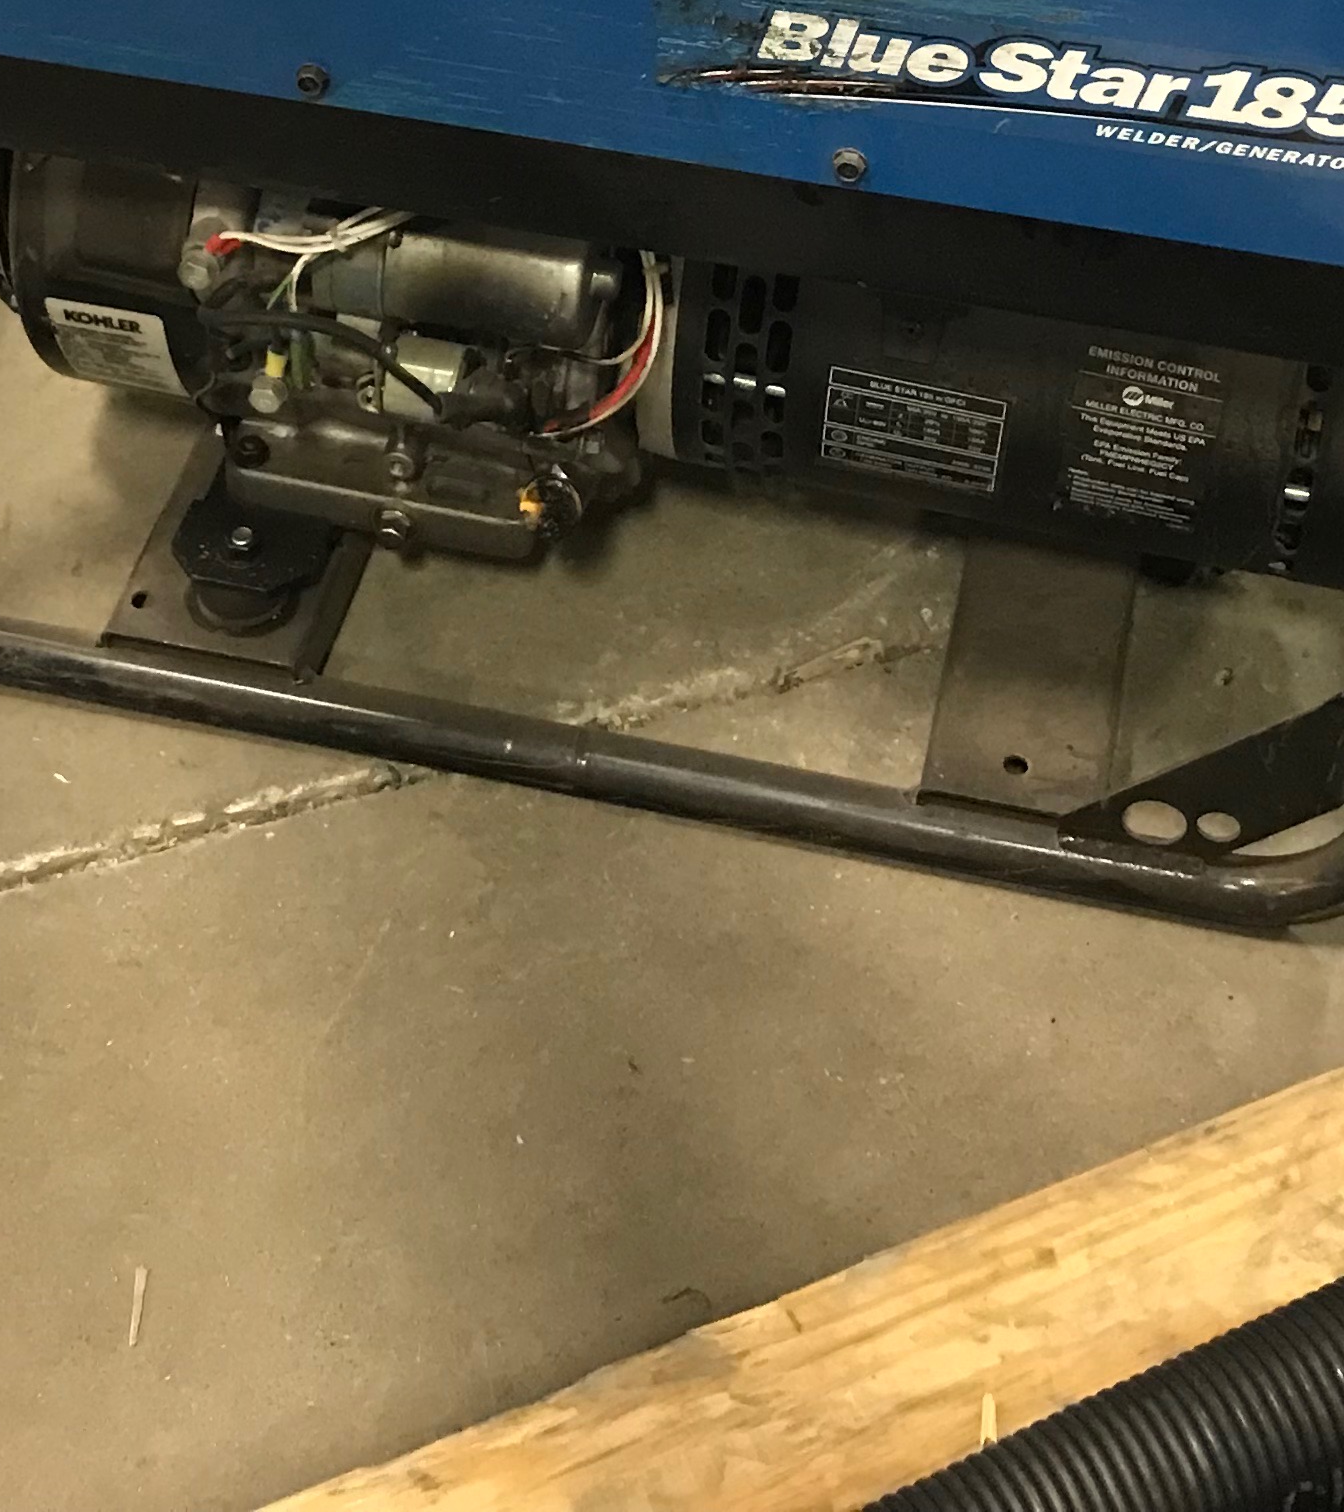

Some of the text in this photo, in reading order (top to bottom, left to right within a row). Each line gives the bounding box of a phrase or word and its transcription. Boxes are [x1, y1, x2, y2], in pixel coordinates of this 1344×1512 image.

[757, 9, 971, 84] Blue
[979, 41, 1189, 115] Star
[62, 307, 143, 335] KOHLER
[1088, 344, 1221, 383] EMISSION CONTROL
[869, 380, 892, 391] BLUE
[894, 385, 917, 396] STAR
[1105, 362, 1198, 393] INFORMATION
[1085, 398, 1118, 413] MILLER
[1119, 405, 1163, 422] ELECTRIC
[1144, 393, 1174, 410] Miller
[1173, 433, 1186, 442] US
